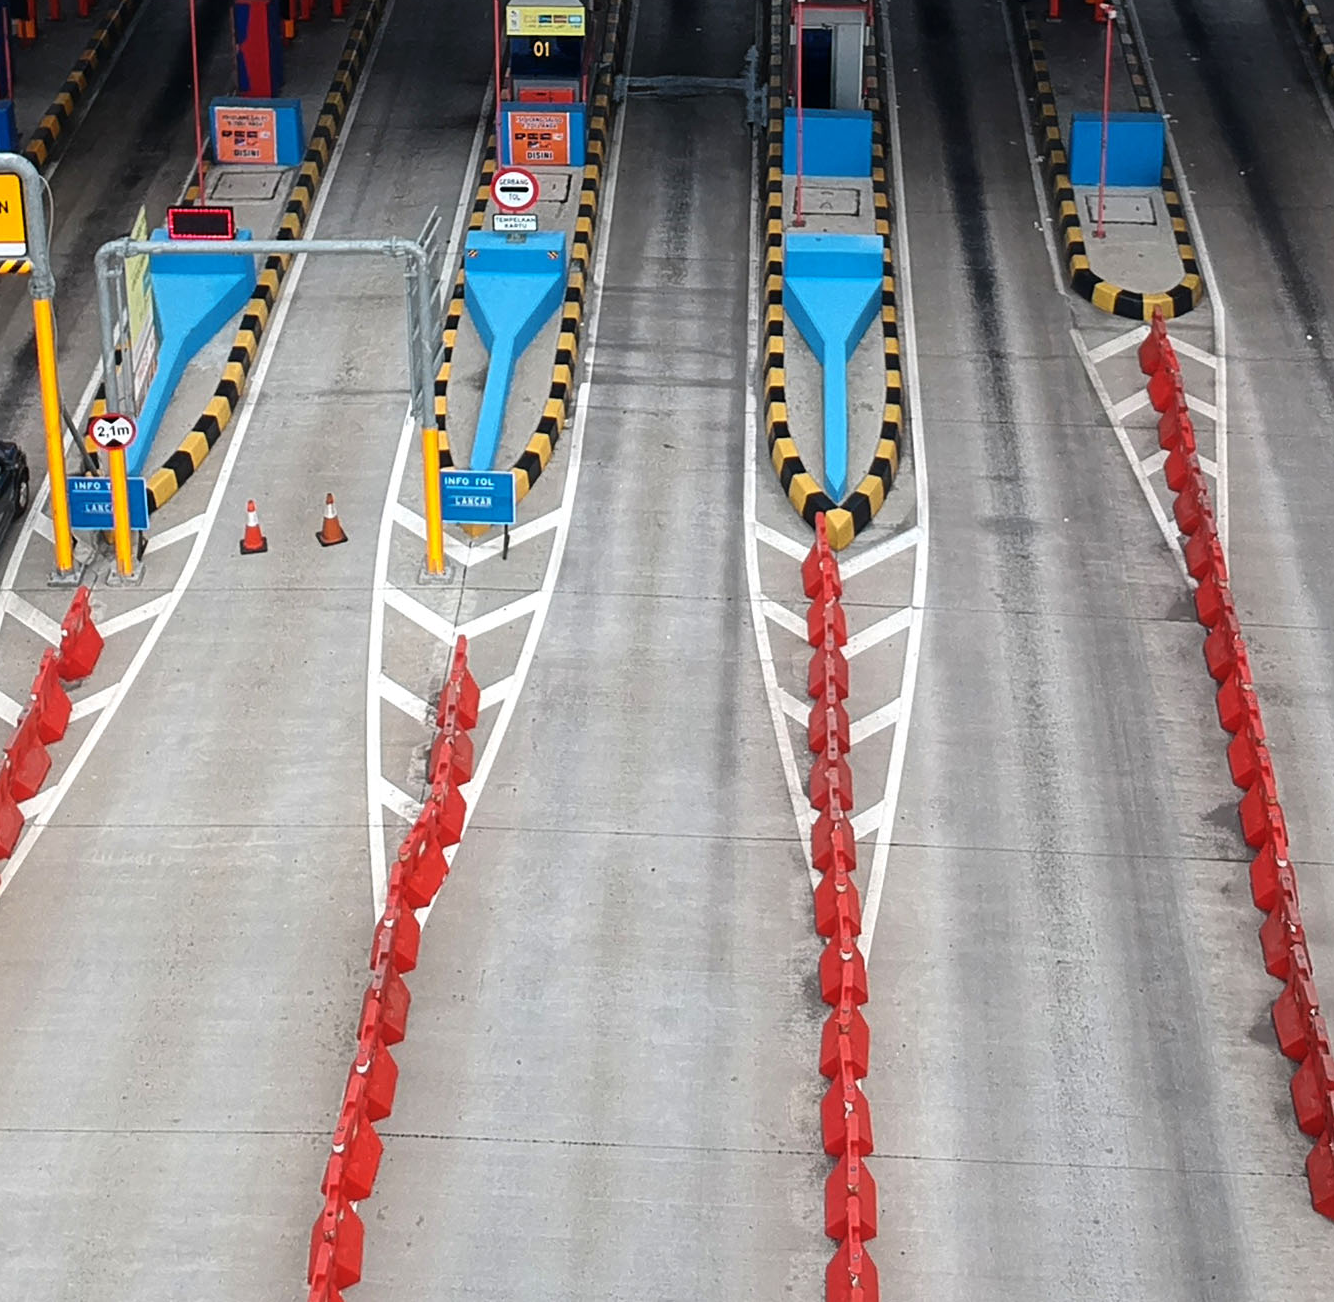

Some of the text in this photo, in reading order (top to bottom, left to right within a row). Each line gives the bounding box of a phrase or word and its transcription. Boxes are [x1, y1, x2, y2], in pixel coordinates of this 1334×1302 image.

[534, 41, 550, 57] 01
[527, 151, 553, 159] DISINI
[499, 178, 529, 186] GERBANG
[509, 193, 521, 201] TOL
[97, 426, 130, 438] 2,1m
[74, 481, 101, 490] INFO
[444, 477, 495, 486] INFO TOL
[454, 497, 492, 506] LANCAR
